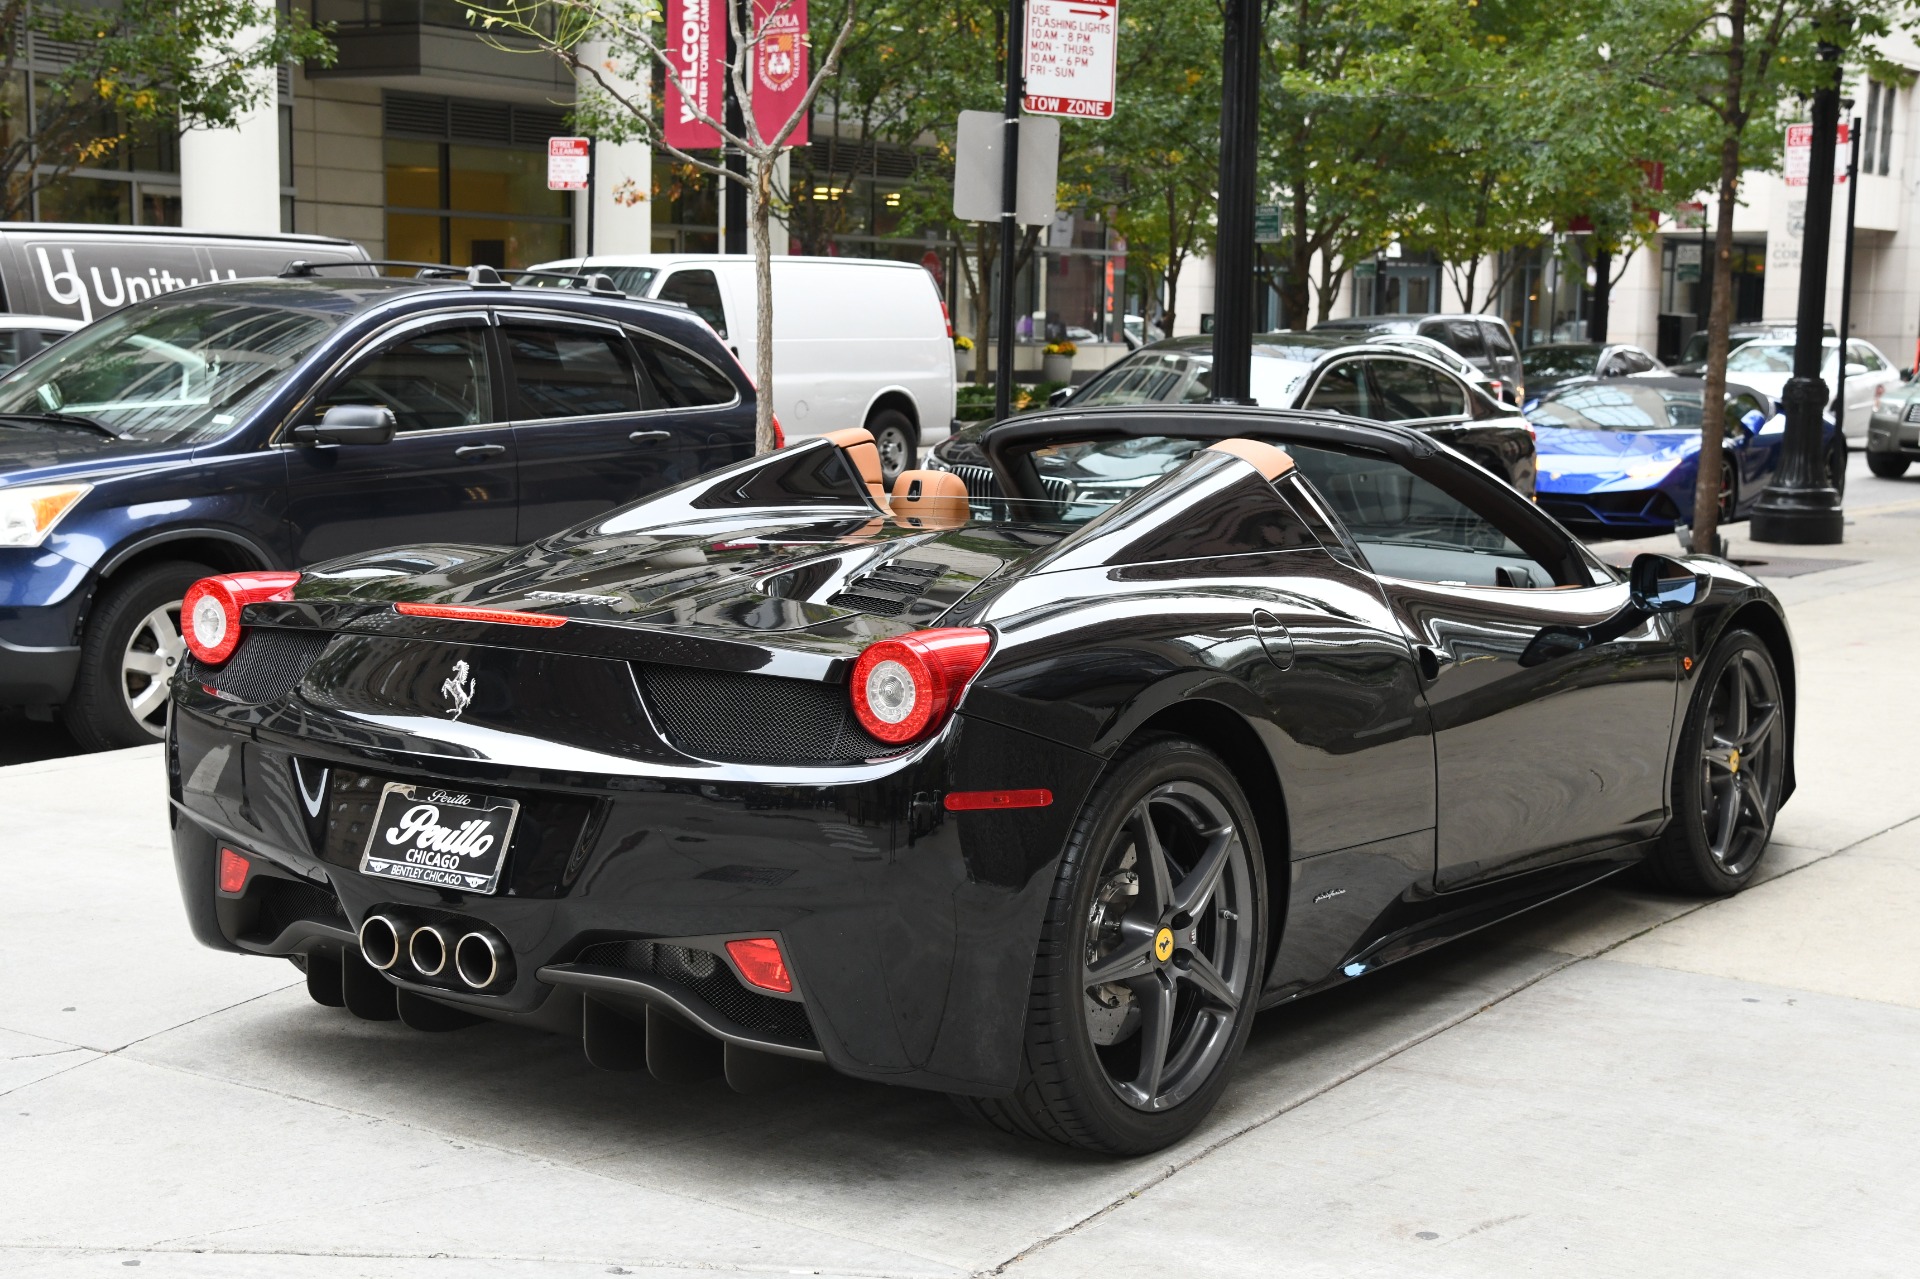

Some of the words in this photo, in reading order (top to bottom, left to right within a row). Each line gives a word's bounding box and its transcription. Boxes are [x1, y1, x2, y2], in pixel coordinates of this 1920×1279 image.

[1032, 5, 1051, 16] USE
[1031, 16, 1077, 31] FLASHING
[1079, 22, 1111, 35] LIGHTS
[1031, 28, 1042, 39] 10
[1044, 30, 1058, 40] AM
[1067, 32, 1074, 42] 8
[1077, 33, 1091, 43] PM
[700, 33, 710, 79] TOWER
[1031, 41, 1052, 52] MON
[1063, 43, 1095, 56] THURS
[680, 0, 700, 124] WELCOM
[1031, 52, 1040, 63] 10
[1041, 54, 1056, 64] AM
[1066, 56, 1073, 66] 6
[1075, 57, 1089, 67] PM
[1030, 64, 1046, 75] FRI
[1055, 67, 1075, 78] SUN
[699, 81, 709, 124] ATER
[1028, 96, 1060, 112] TOW
[1066, 100, 1106, 116] ZONE
[427, 789, 472, 806] Perillo
[386, 804, 495, 858] Perillo
[405, 848, 460, 870] CHICAGO
[390, 864, 424, 879] BENTLEY
[424, 869, 462, 885] CHICAGO
